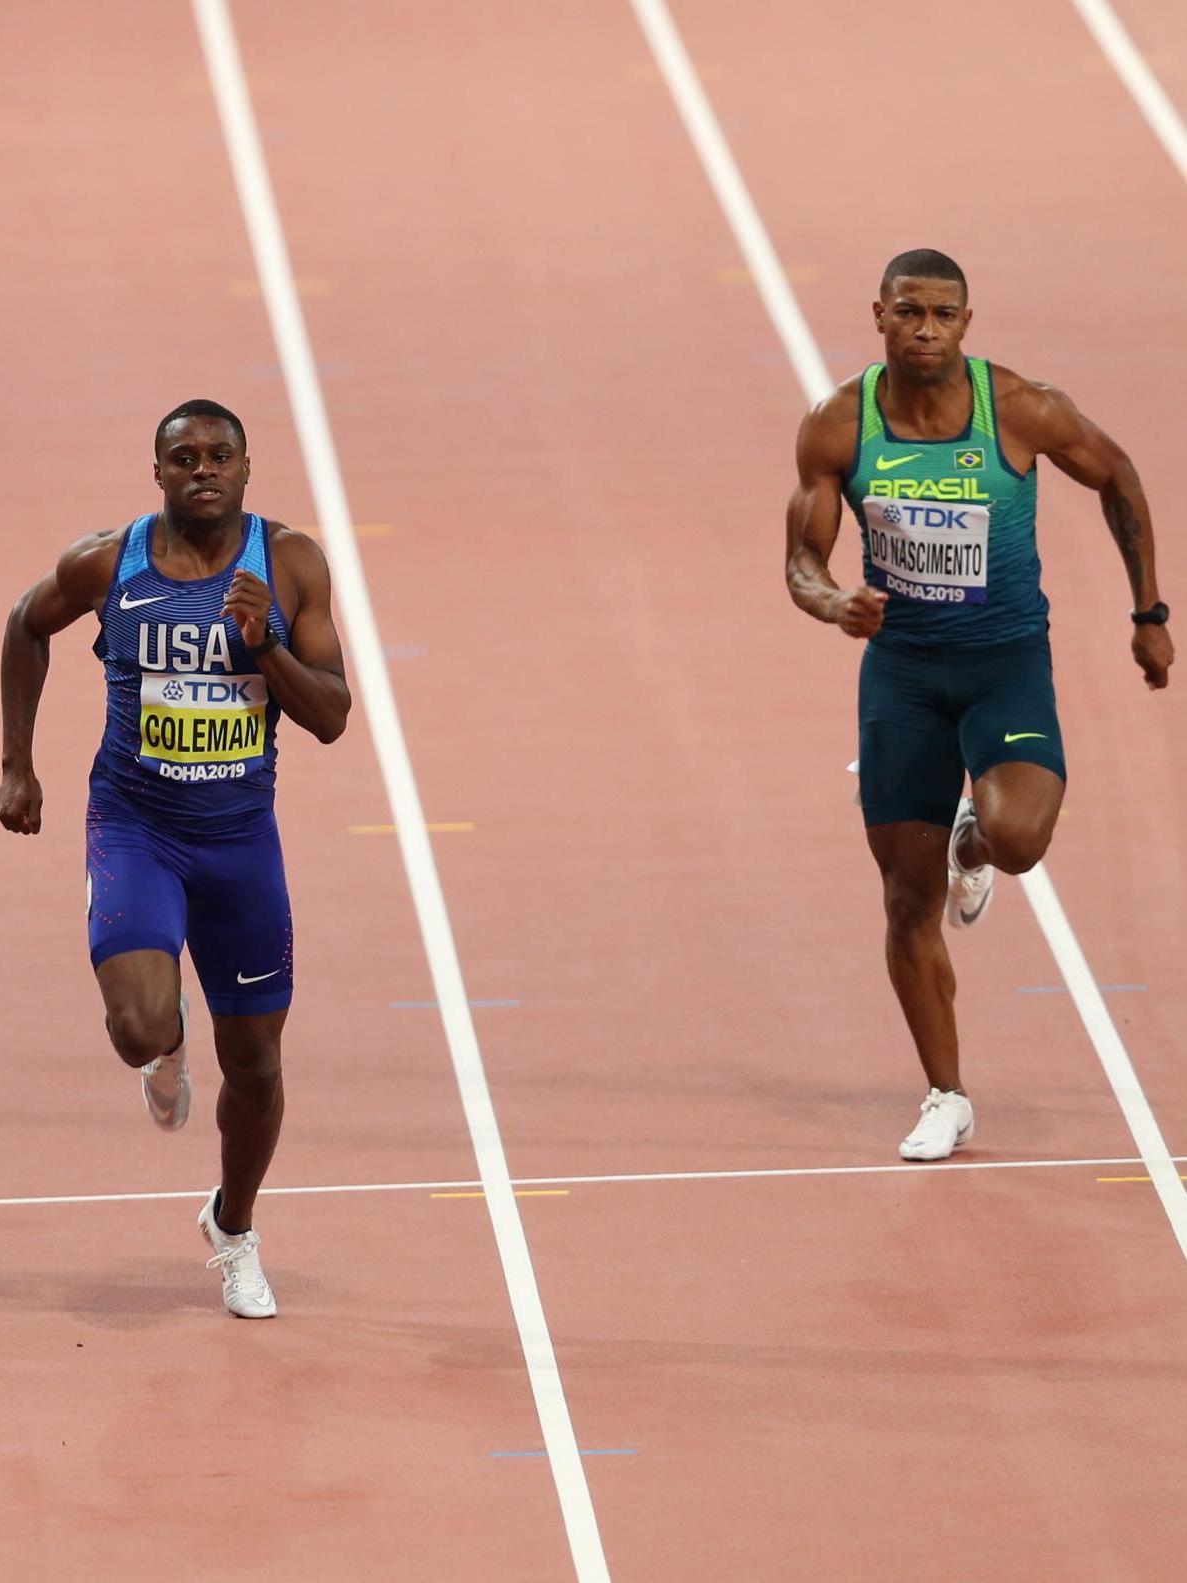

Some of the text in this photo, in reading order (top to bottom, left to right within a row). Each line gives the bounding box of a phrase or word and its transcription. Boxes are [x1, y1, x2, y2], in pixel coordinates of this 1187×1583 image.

[869, 478, 989, 499] BRASIL
[902, 506, 969, 529] TDK
[871, 529, 982, 576] DO NASCIMENTO
[886, 575, 965, 602] DOHA2019
[138, 623, 234, 672] USA
[184, 681, 253, 704] TDK
[145, 714, 260, 753] COLEMAN
[159, 762, 246, 782] DOHA2019
